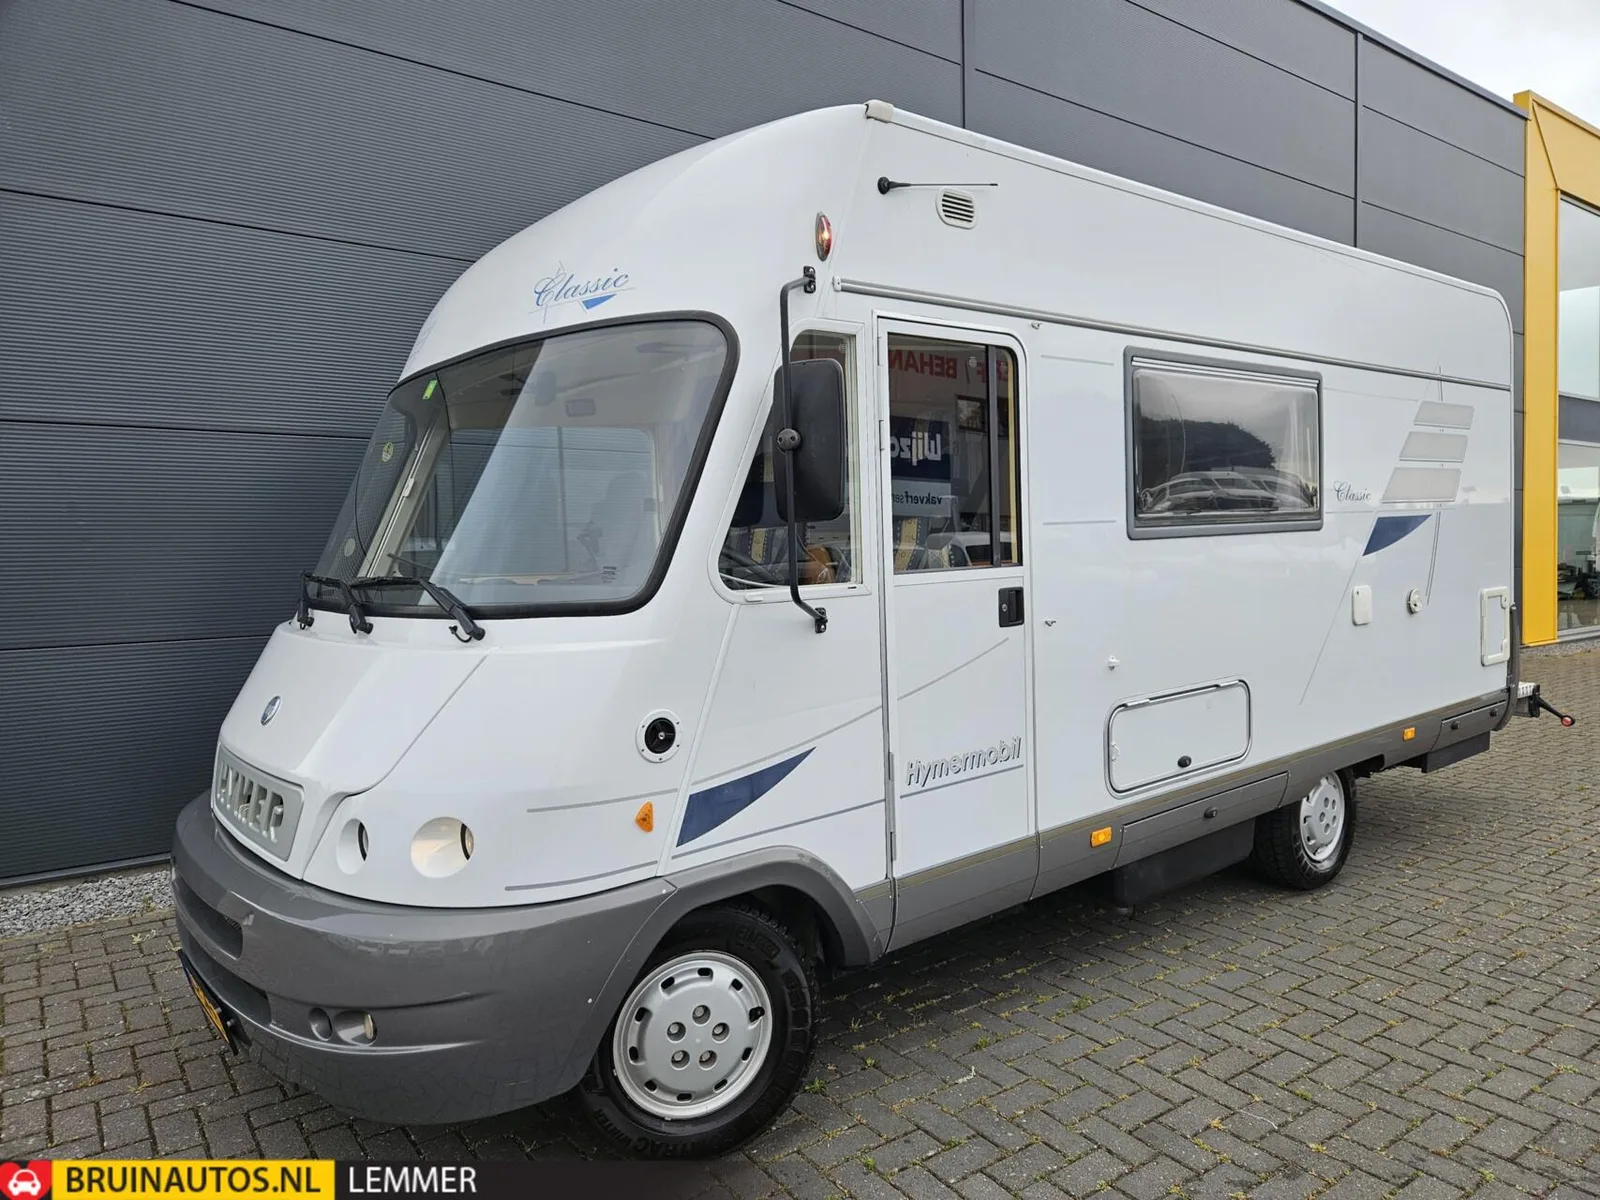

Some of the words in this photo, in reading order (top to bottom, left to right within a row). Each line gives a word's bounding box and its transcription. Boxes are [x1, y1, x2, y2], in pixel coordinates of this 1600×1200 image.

[533, 265, 629, 307] Classic
[1333, 480, 1372, 502] Classic
[905, 735, 1022, 788] Hymermobil
